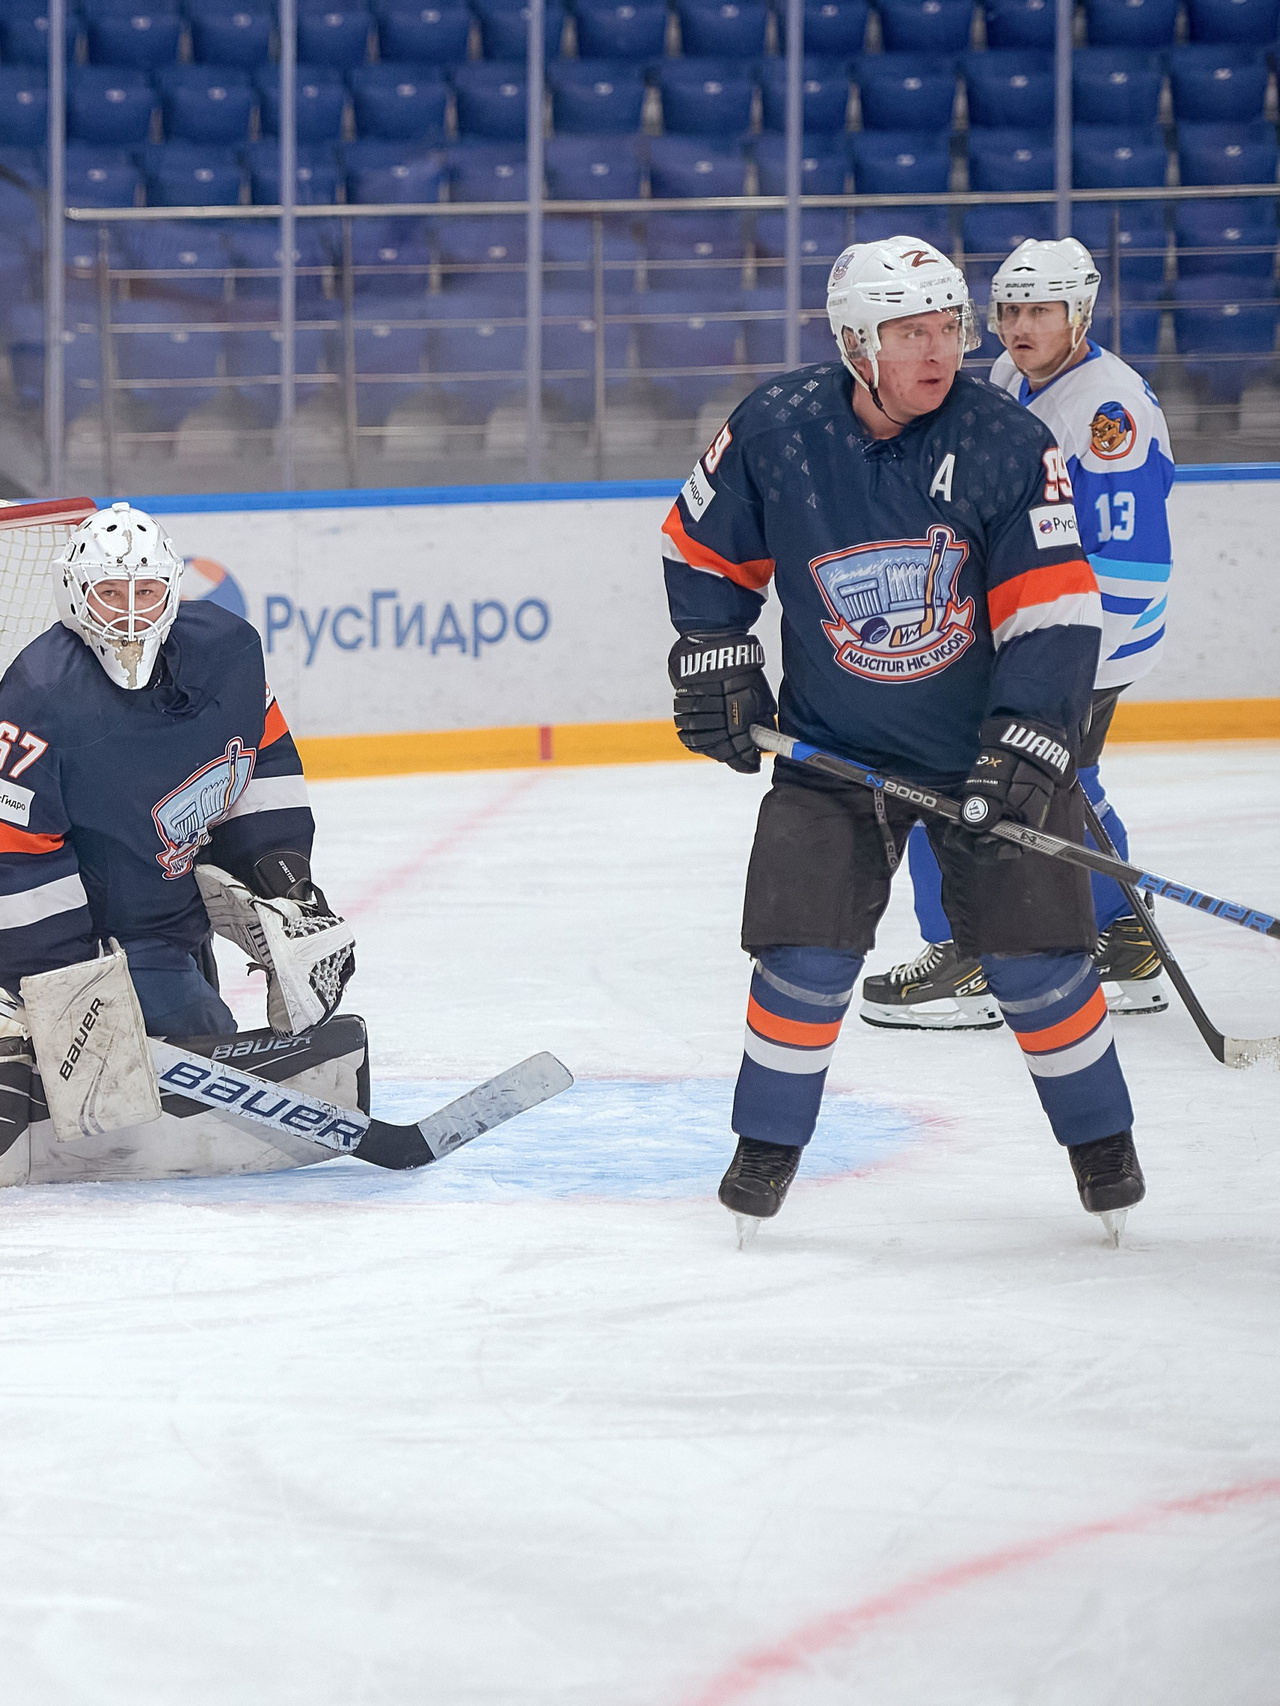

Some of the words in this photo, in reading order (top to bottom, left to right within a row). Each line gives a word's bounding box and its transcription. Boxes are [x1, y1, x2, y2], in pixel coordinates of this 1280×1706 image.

[929, 453, 956, 502] A
[1052, 515, 1078, 533] Рус
[1095, 491, 1136, 542] 13
[264, 589, 551, 668] РусГидро
[844, 649, 905, 673] NASCITUR
[907, 654, 930, 671] HIC
[928, 632, 968, 663] VIGOR
[1136, 872, 1275, 935] BAUER
[59, 997, 105, 1082] BAUER
[160, 1060, 370, 1149] BAUER
